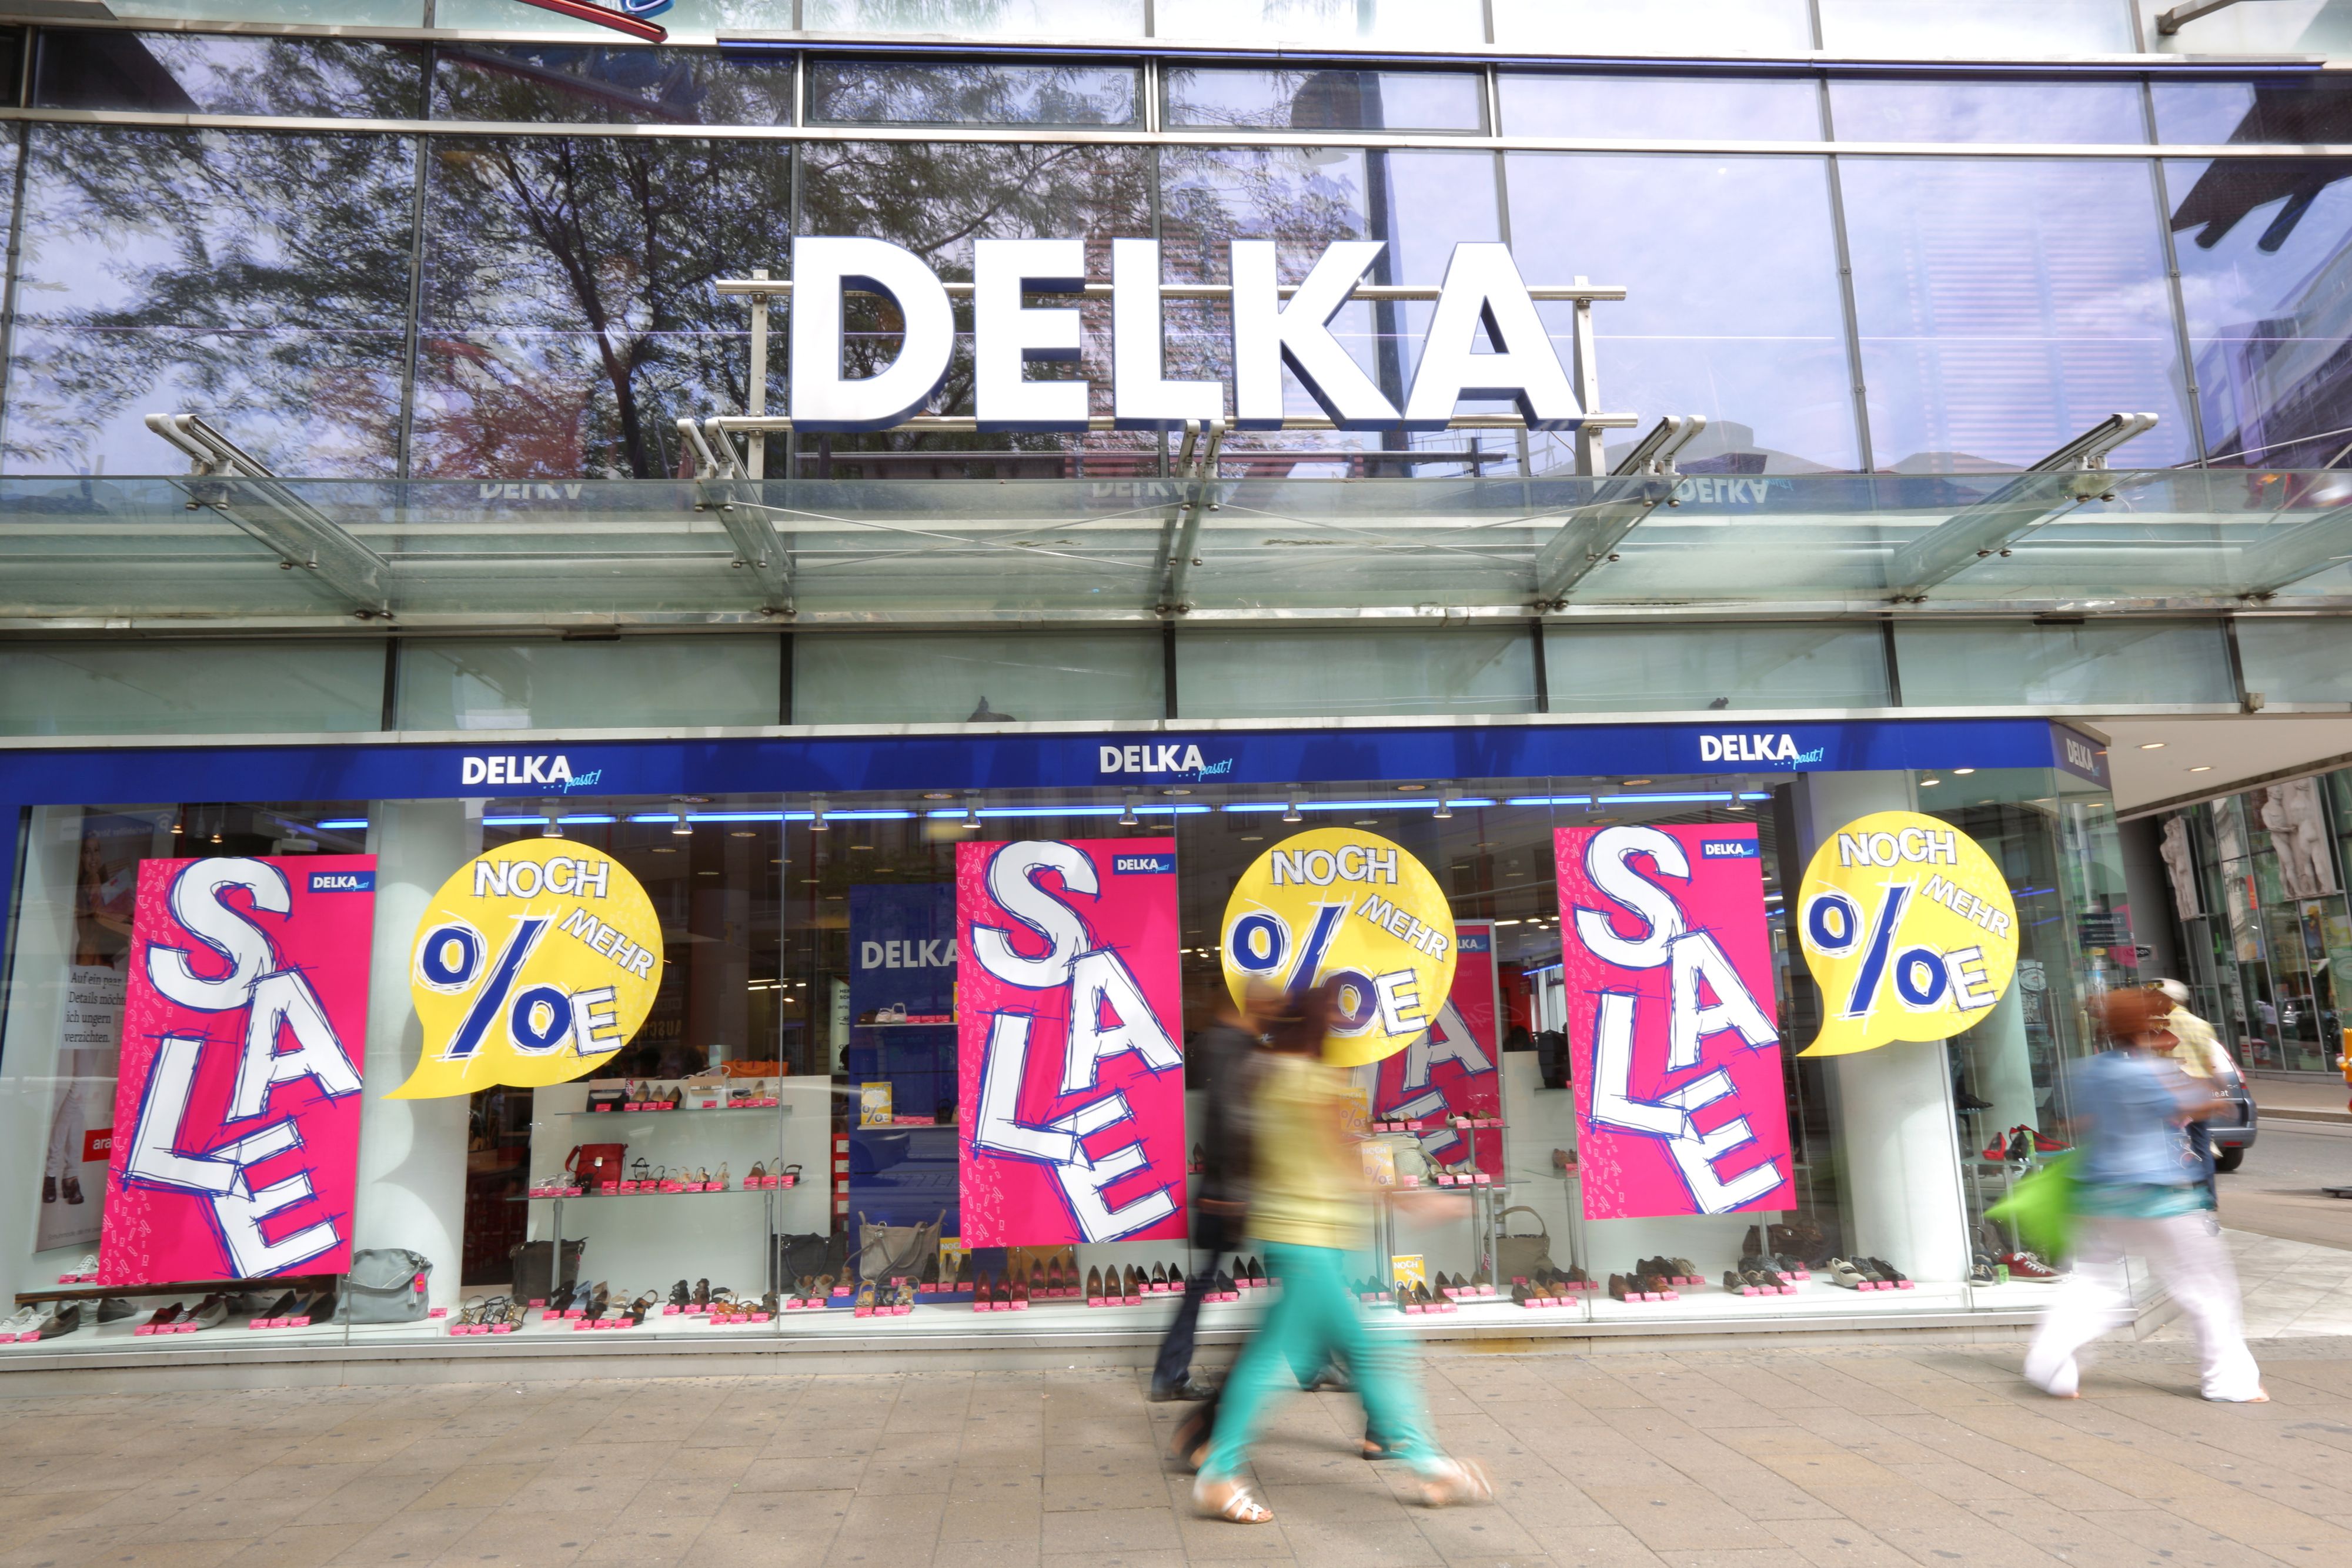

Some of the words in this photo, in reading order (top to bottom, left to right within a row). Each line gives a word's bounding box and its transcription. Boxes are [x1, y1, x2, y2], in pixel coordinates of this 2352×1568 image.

[791, 236, 1585, 431] DELKA
[1100, 744, 1205, 773] DELKA
[1699, 734, 1799, 761] DELKA
[2066, 738, 2094, 772] DELKA
[462, 755, 572, 784] DELKA
[1705, 842, 1743, 855] DELKA
[1839, 827, 1957, 867] NOCH
[473, 856, 609, 898] NOCH
[1117, 858, 1158, 870] DELKA
[1270, 844, 1398, 887] NOCH
[313, 875, 358, 888] DELKA
[1920, 874, 2010, 938] MEHR
[1355, 894, 1449, 962] MEHR
[559, 907, 655, 979] MEHR
[861, 939, 957, 969] DELKA
[1458, 939, 1478, 949] LKA
[70, 972, 89, 984] Auf
[88, 974, 101, 985] ein
[102, 978, 122, 989] paar
[68, 991, 98, 1004] Details
[66, 1010, 79, 1023] ich
[82, 1013, 111, 1027] ungern
[1575, 825, 1788, 1215] SALE
[64, 1030, 110, 1043] verzichten.
[970, 840, 1182, 1243] SALE
[121, 857, 363, 1279] SALE
[940, 1242, 961, 1251] NOC
[1394, 1261, 1418, 1269] NOCH
